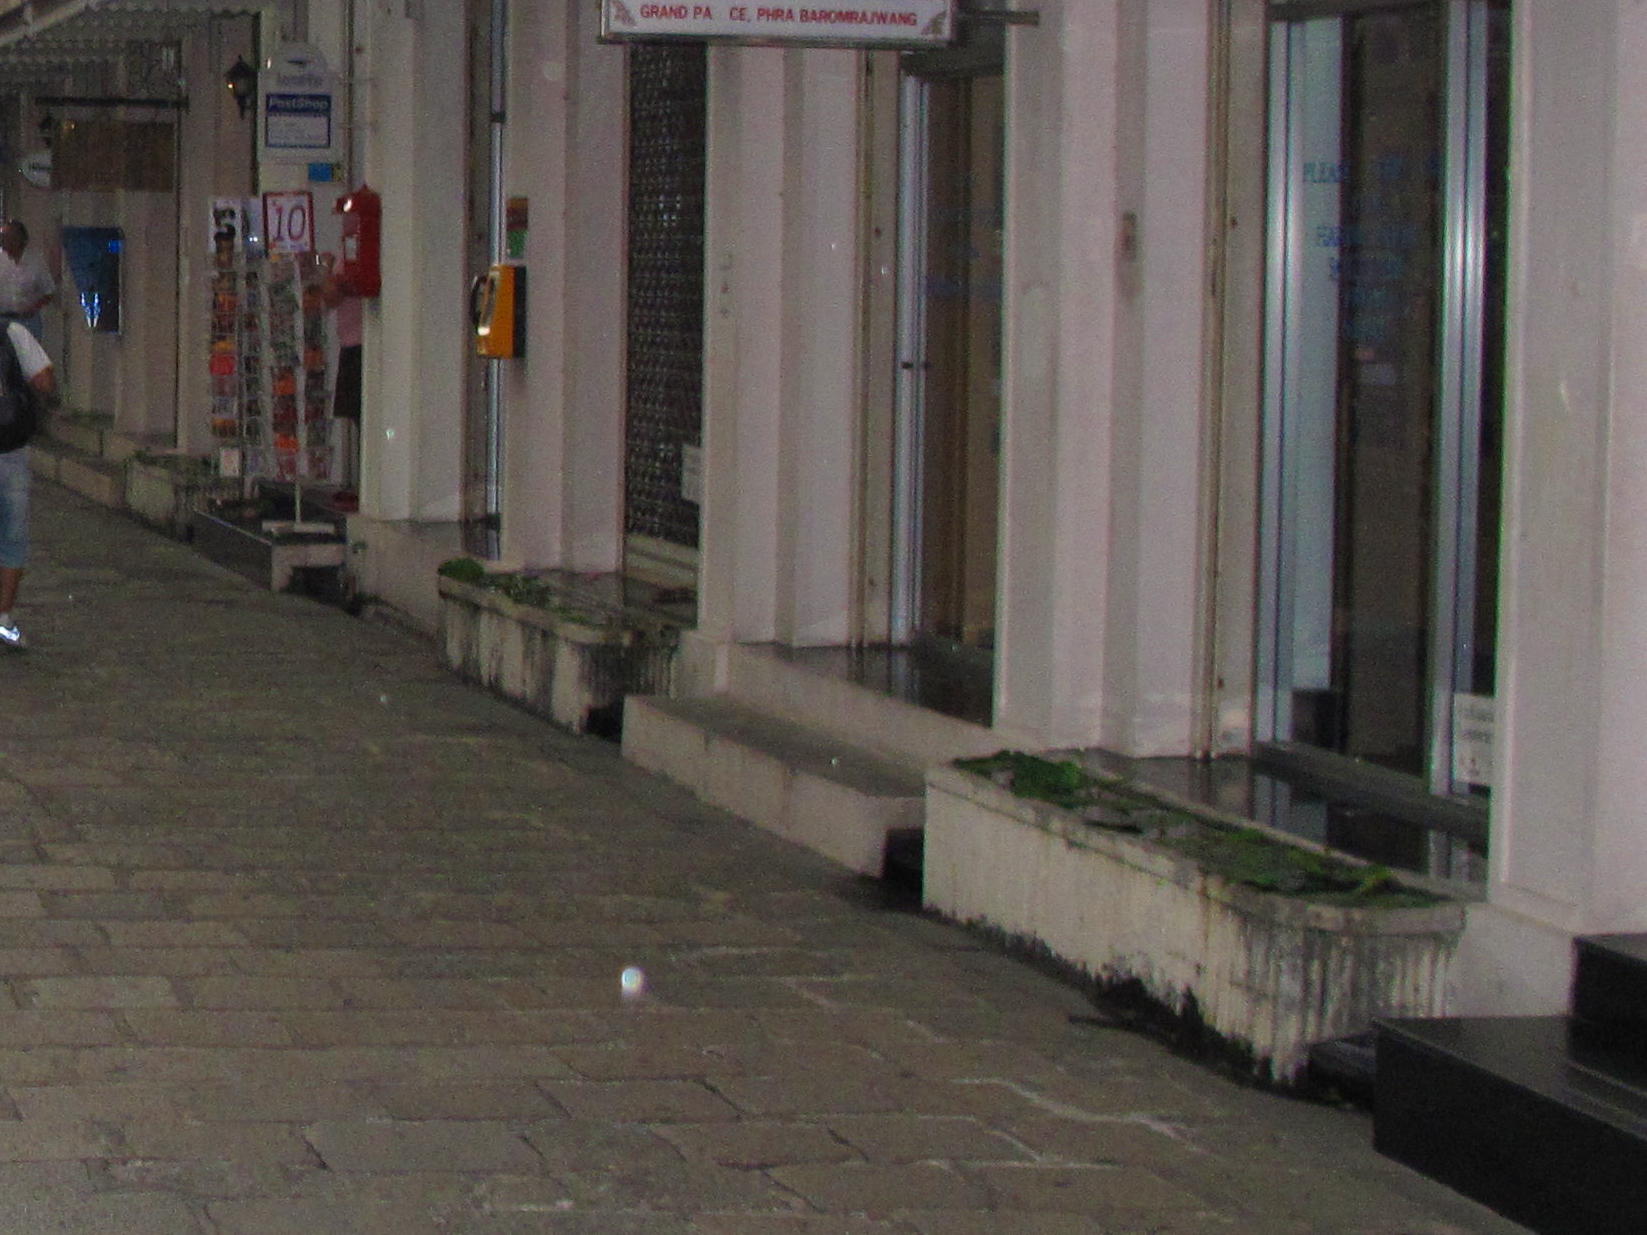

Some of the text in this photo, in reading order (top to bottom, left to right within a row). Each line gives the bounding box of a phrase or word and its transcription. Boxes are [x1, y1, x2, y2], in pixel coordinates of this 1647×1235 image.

[640, 5, 688, 20] GRAND
[757, 8, 794, 23] PHRA
[274, 205, 306, 242] 10
